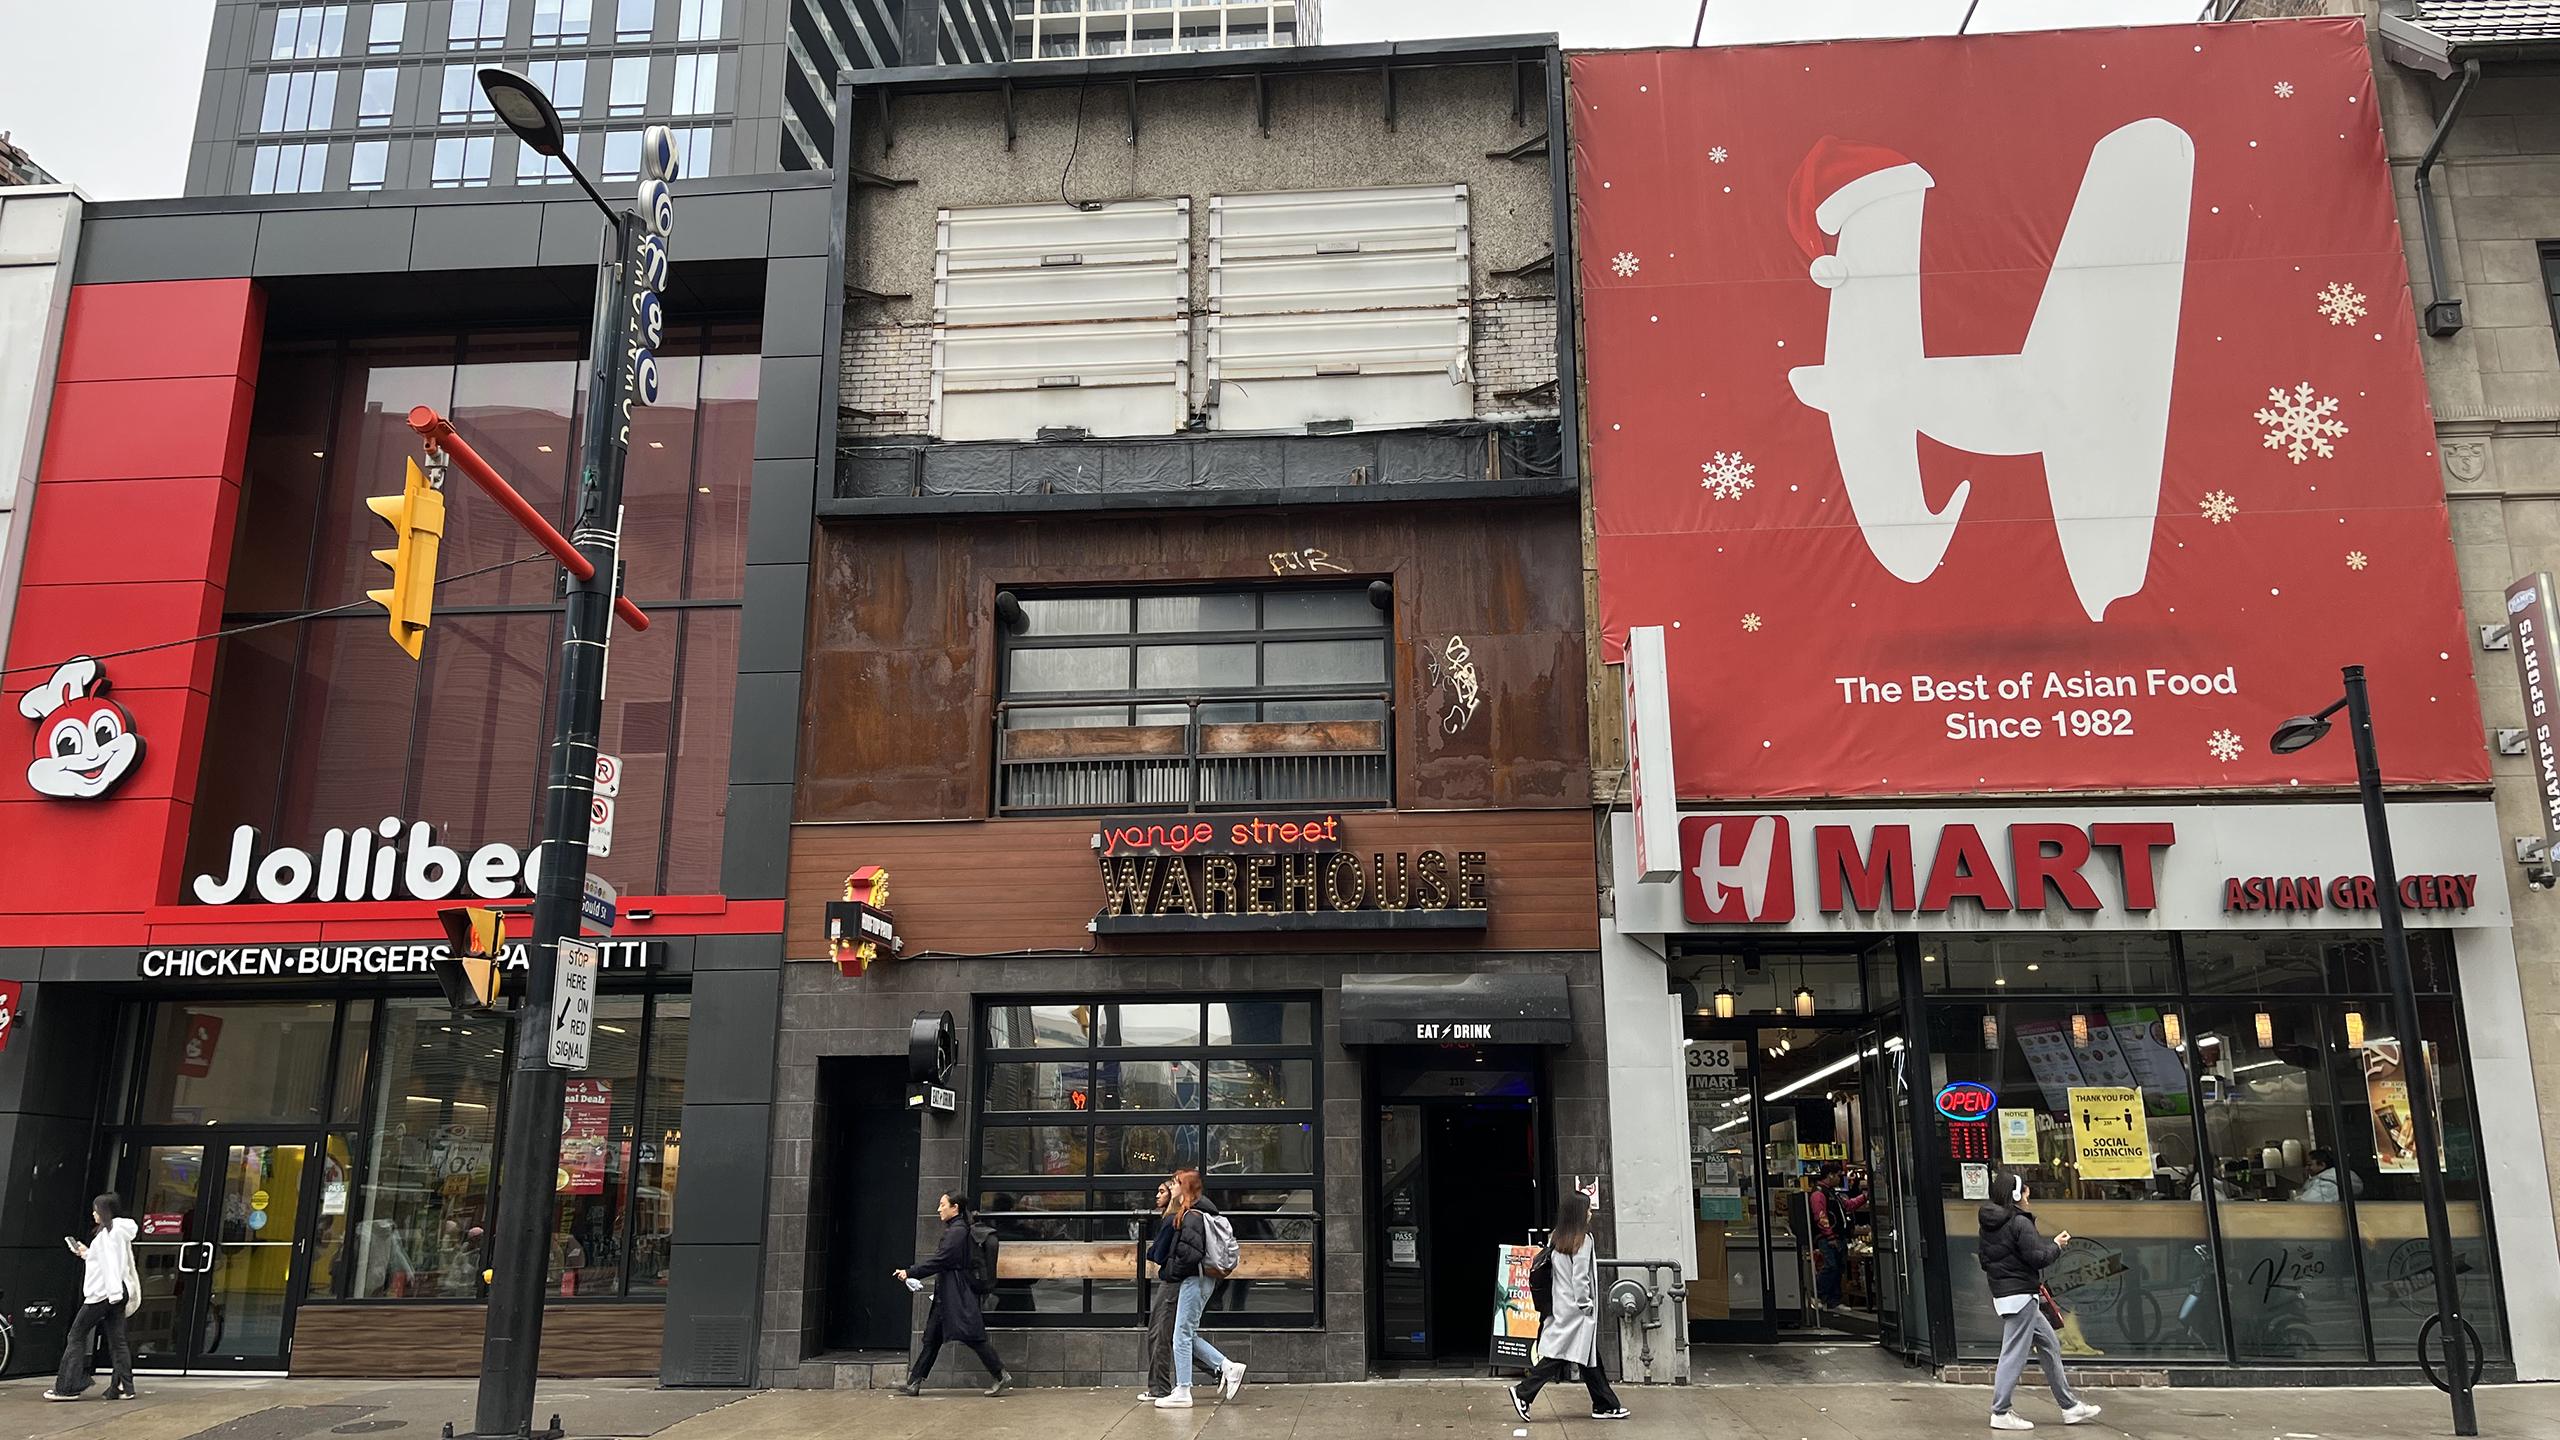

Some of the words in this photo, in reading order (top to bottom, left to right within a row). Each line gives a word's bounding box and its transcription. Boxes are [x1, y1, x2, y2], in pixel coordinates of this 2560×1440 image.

[1788, 117, 2195, 623] H
[2519, 618, 2546, 718] SPORTS
[1835, 677, 1902, 704] The
[1911, 674, 1990, 702] Best
[1998, 672, 2034, 700] of
[2042, 670, 2137, 699] Asian
[2146, 667, 2238, 697] Food
[1945, 711, 2042, 740] Since
[2051, 709, 2134, 738] 1982
[1104, 822, 1213, 856] yonge
[1231, 815, 1337, 845] street
[1692, 816, 1776, 923] H
[1813, 822, 2176, 912] MART
[1099, 850, 1488, 917] WAREHOUSE
[2224, 876, 2324, 911] ASIAN
[2328, 874, 2478, 910] GRCERY
[143, 946, 283, 978] CHICKEN
[298, 945, 450, 975] BURGERS
[568, 949, 589, 968] STOP
[566, 972, 588, 991] HERE
[577, 998, 588, 1014] ON
[570, 1020, 587, 1036] RED
[1417, 1024, 1439, 1038] EAT
[1454, 1024, 1492, 1038] DRINK
[555, 1040, 584, 1059] SIGNAL
[1689, 1050, 1730, 1067] 338
[1695, 1076, 1738, 1089] MART
[564, 1094, 579, 1103] eal
[1940, 1092, 1990, 1111] OPEN
[2083, 1147, 2143, 1157] DISTANCING
[2093, 1138, 2129, 1147] SOCIAL
[328, 1184, 345, 1192] PASS
[1394, 1232, 1413, 1240] PASS
